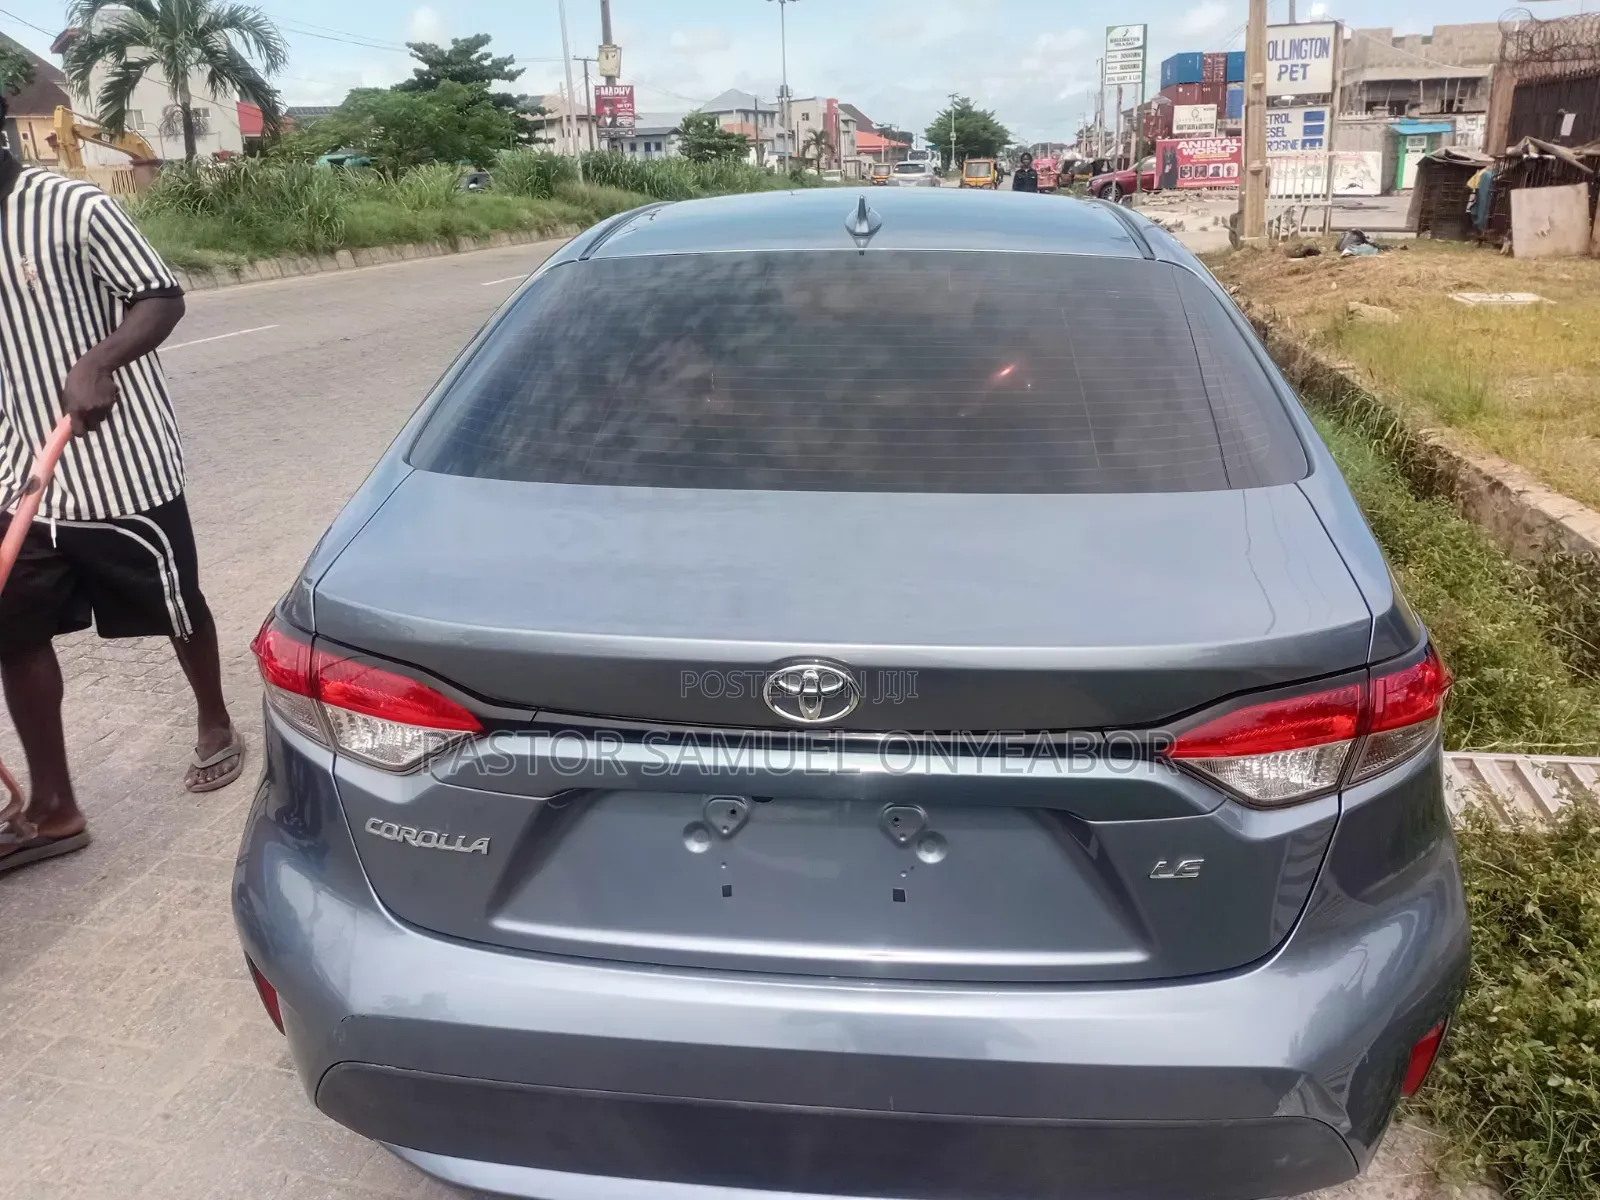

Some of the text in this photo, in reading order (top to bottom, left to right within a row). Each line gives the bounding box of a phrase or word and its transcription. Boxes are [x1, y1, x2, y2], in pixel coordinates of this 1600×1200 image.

[1267, 37, 1330, 61] OLLINGTON
[1277, 63, 1311, 82] PET
[1266, 113, 1292, 125] TROL
[1266, 126, 1287, 138] ESEL
[1177, 139, 1241, 149] ANIMAL
[1182, 146, 1238, 155] WORLD
[365, 817, 491, 855] COROLLA
[1149, 858, 1205, 879] LE
